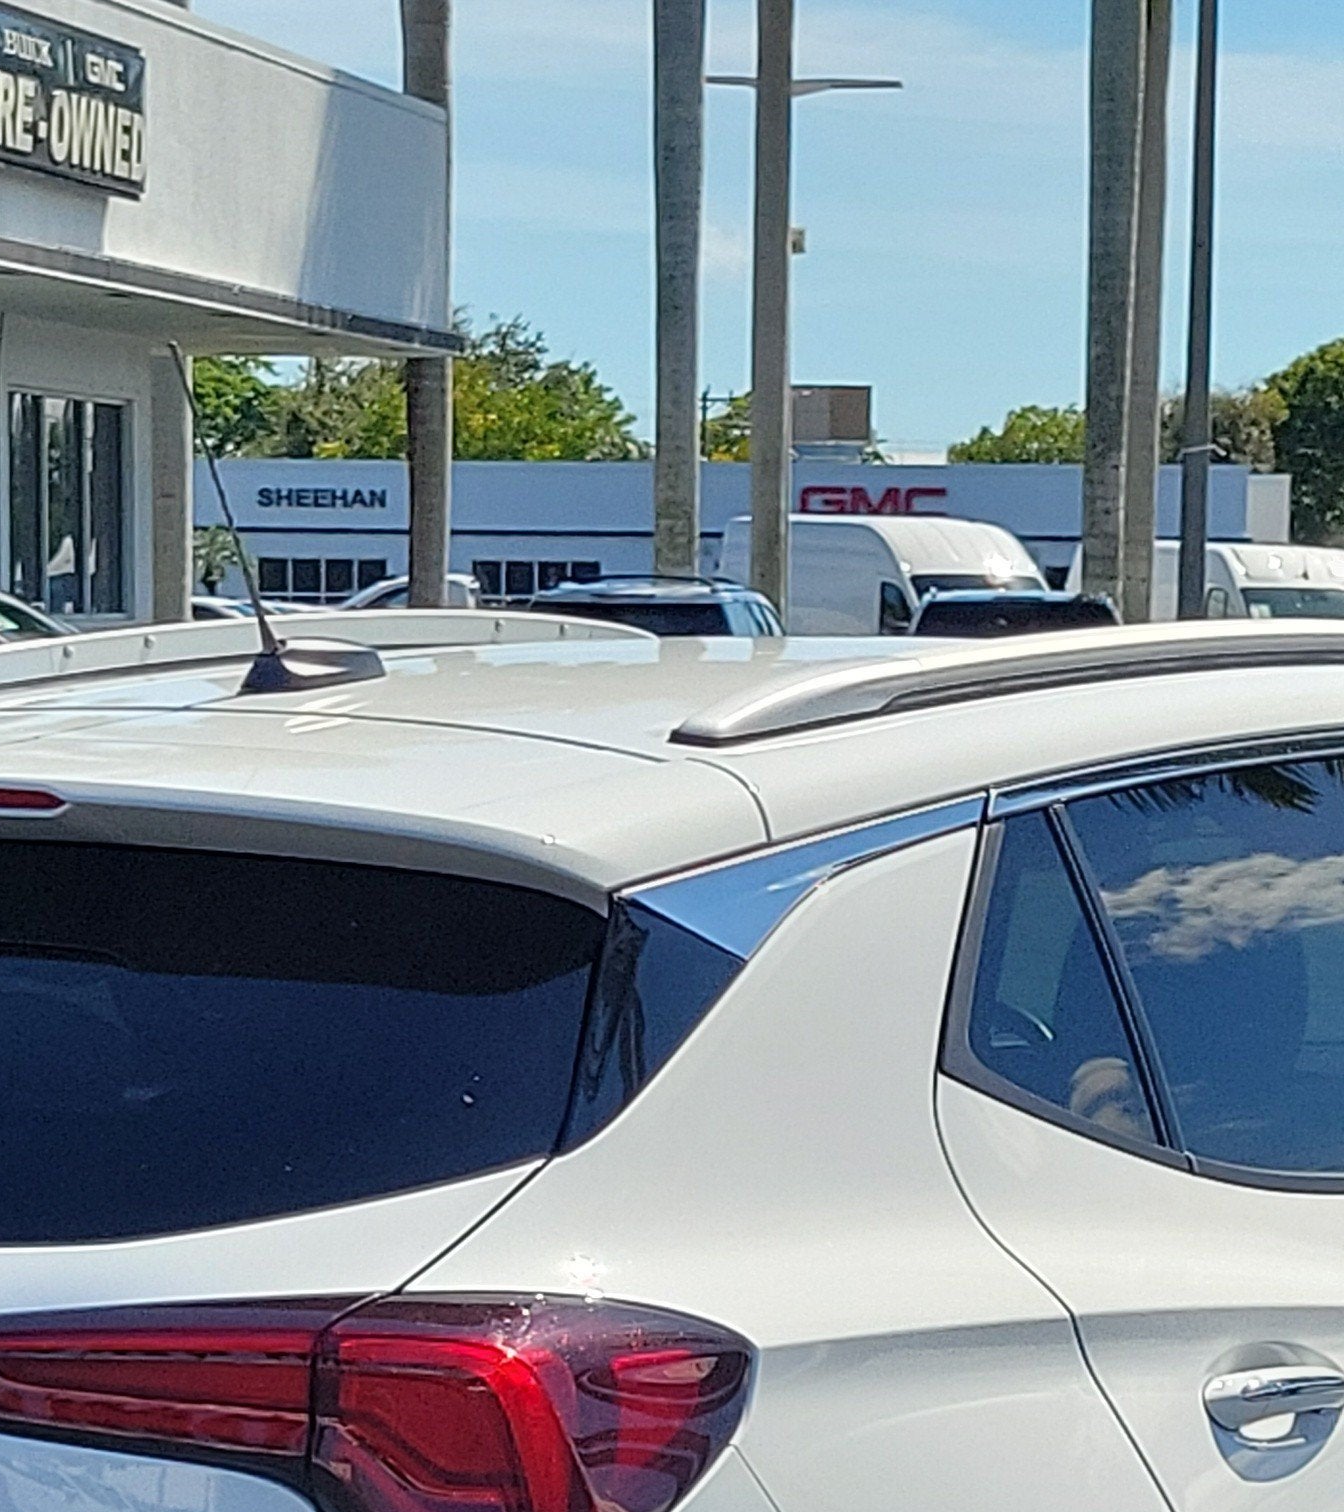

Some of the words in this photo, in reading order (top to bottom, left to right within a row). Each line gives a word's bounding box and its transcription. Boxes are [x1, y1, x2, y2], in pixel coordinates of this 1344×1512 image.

[2, 28, 54, 67] BUICK
[84, 52, 127, 92] GMC
[256, 486, 388, 509] SHEEHAN
[800, 486, 948, 516] GMC
